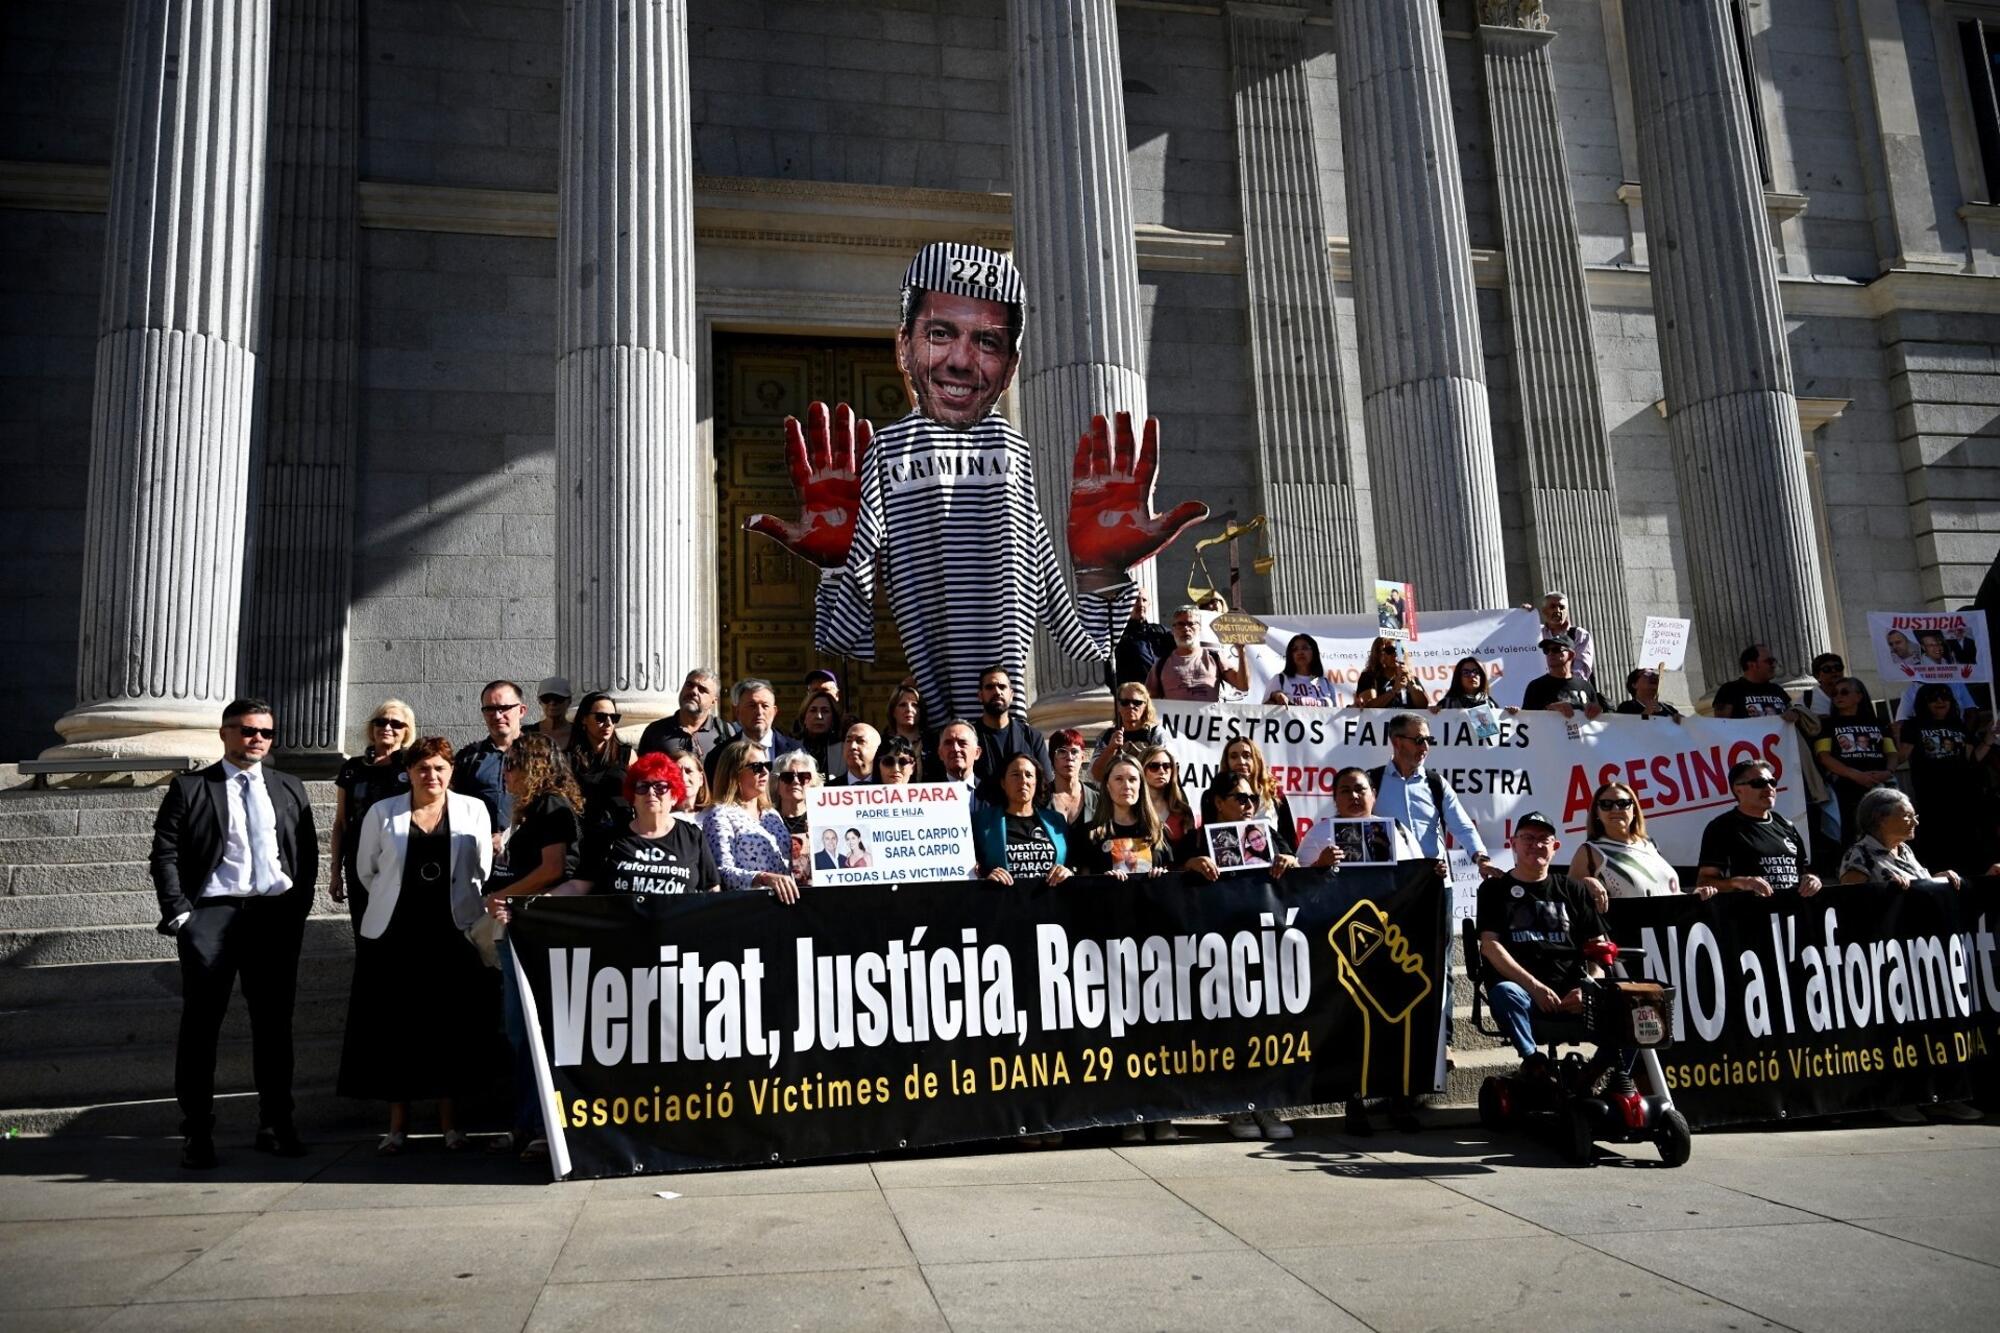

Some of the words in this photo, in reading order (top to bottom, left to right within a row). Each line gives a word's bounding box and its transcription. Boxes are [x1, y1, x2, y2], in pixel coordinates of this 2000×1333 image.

[951, 259, 999, 288] 228
[891, 456, 1014, 483] CRIMINAL
[1892, 616, 1966, 630] JUSTICIA
[1454, 647, 1482, 656] DANA
[1162, 713, 1324, 745] NUESTROS
[1344, 721, 1529, 749] FAIAES
[1834, 726, 1881, 736] JUSTICIA
[1271, 765, 1337, 793] ERTO
[1443, 768, 1532, 795] ESTRA
[907, 787, 958, 803] PARA
[856, 808, 890, 818] PADRE
[892, 808, 898, 817] E
[901, 807, 925, 817] HIJA
[872, 829, 915, 843] MIGUEL
[917, 827, 959, 840] CARPIO
[960, 826, 968, 838] Y
[635, 847, 665, 862] NO
[885, 845, 916, 858] SARA
[918, 843, 960, 857] CARPIO
[1007, 851, 1055, 861] VERITAT
[617, 860, 690, 879] l'aforament
[826, 873, 834, 884] Y
[837, 871, 879, 883] TODAS
[882, 869, 906, 880] LAS
[909, 865, 965, 879] VICTIMAS
[1007, 861, 1053, 872] EPARAC
[614, 876, 629, 890] de
[632, 876, 686, 895] MAZÓN
[548, 945, 781, 1069] Veritat,
[793, 926, 1028, 1052] Justícia,
[1036, 907, 1311, 1038] Reparació
[1640, 921, 1726, 1043] NO
[1739, 949, 1772, 1038] a
[1666, 1050, 1780, 1089] ssociació
[1790, 1047, 1885, 1080] Víctimes
[1893, 1037, 1918, 1068] de
[1924, 1033, 1948, 1065] la
[749, 1072, 890, 1115] Víctimes
[904, 1064, 938, 1100] de
[951, 1060, 976, 1095] la
[990, 1052, 1070, 1092] DANA
[1082, 1046, 1112, 1083] 29
[1127, 1039, 1236, 1078] octubre
[1247, 1031, 1311, 1069] 2024
